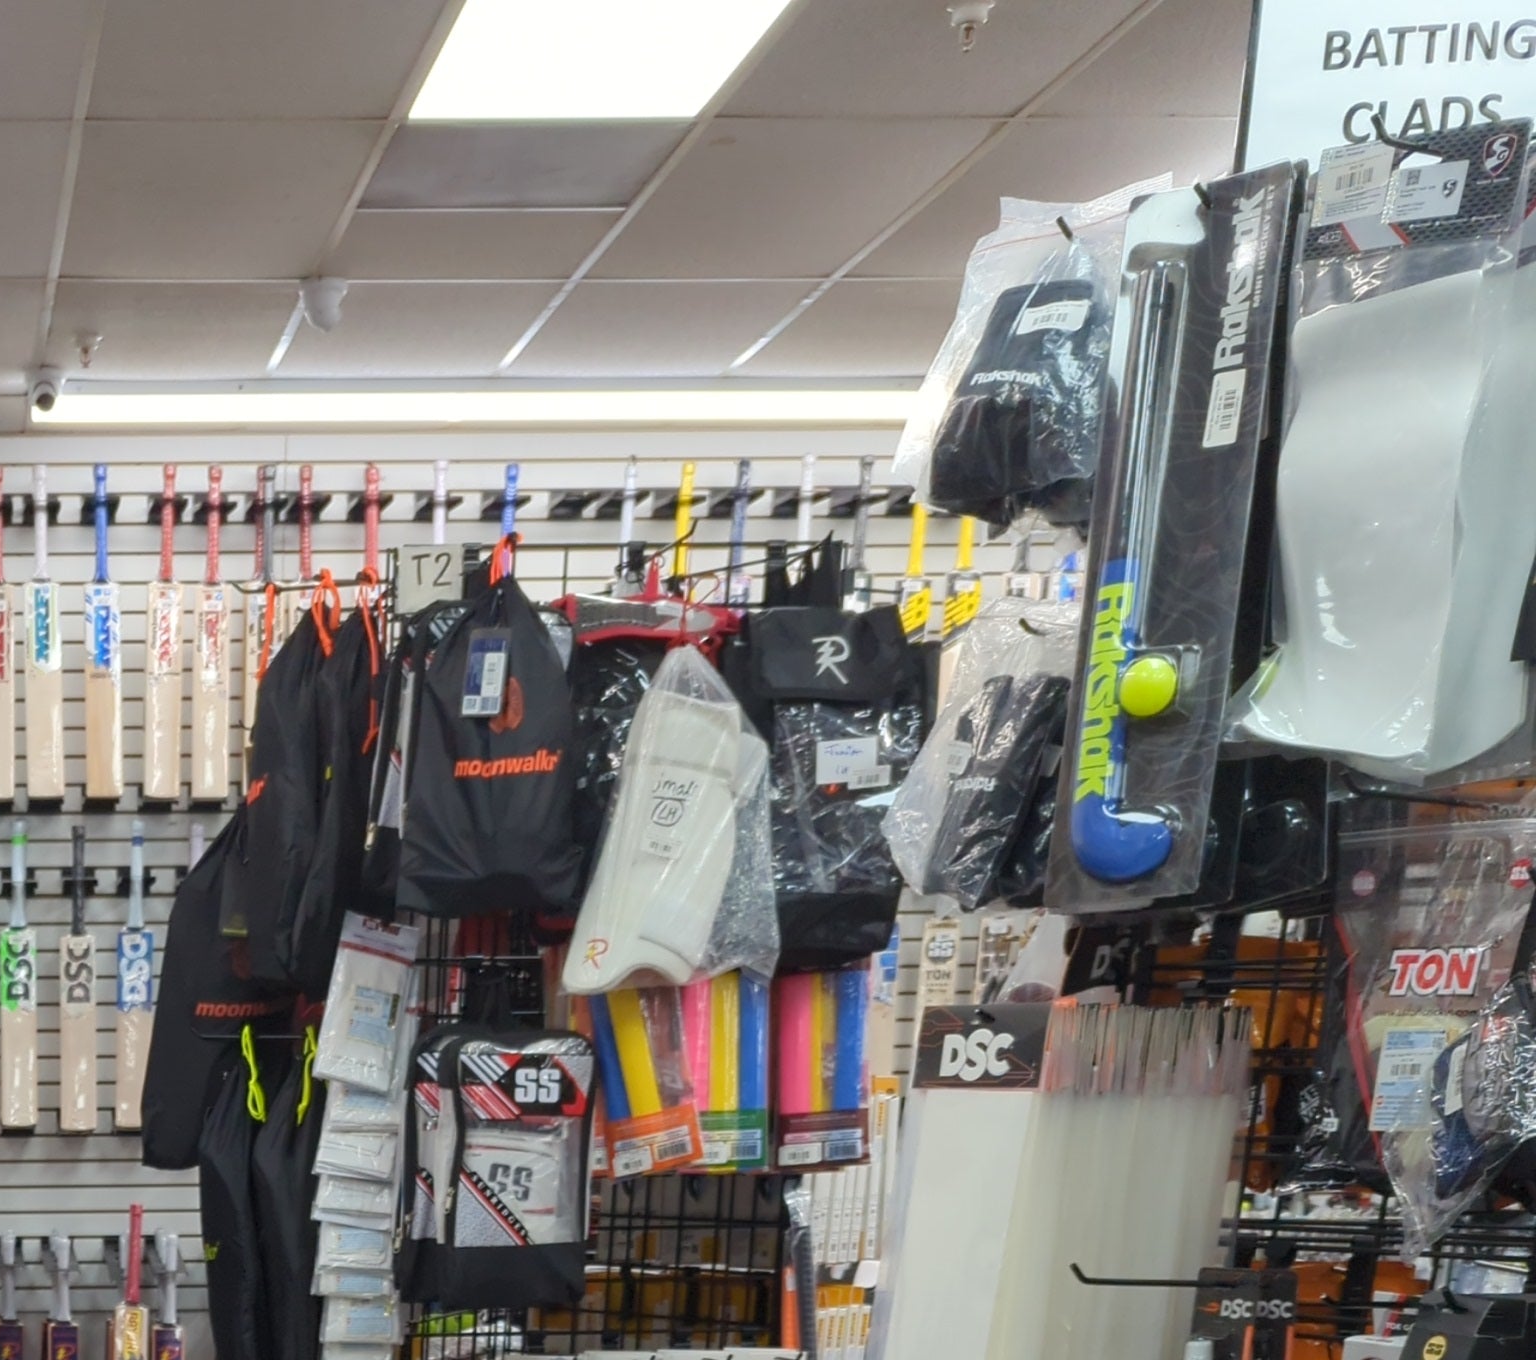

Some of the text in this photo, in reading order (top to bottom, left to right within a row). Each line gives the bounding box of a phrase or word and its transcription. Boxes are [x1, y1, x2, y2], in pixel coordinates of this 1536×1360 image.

[1322, 19, 1536, 71] BATTING
[1213, 187, 1265, 370] Rakshak
[411, 552, 453, 587] T2
[1073, 582, 1135, 804] Rakshak
[454, 748, 558, 778] moonwalkr
[1391, 950, 1481, 996] TON
[939, 1028, 1015, 1082] DSC
[514, 1068, 563, 1104] SS
[488, 1163, 534, 1202] SS
[1219, 1299, 1254, 1319] DSC
[1256, 1299, 1294, 1319] DSC
